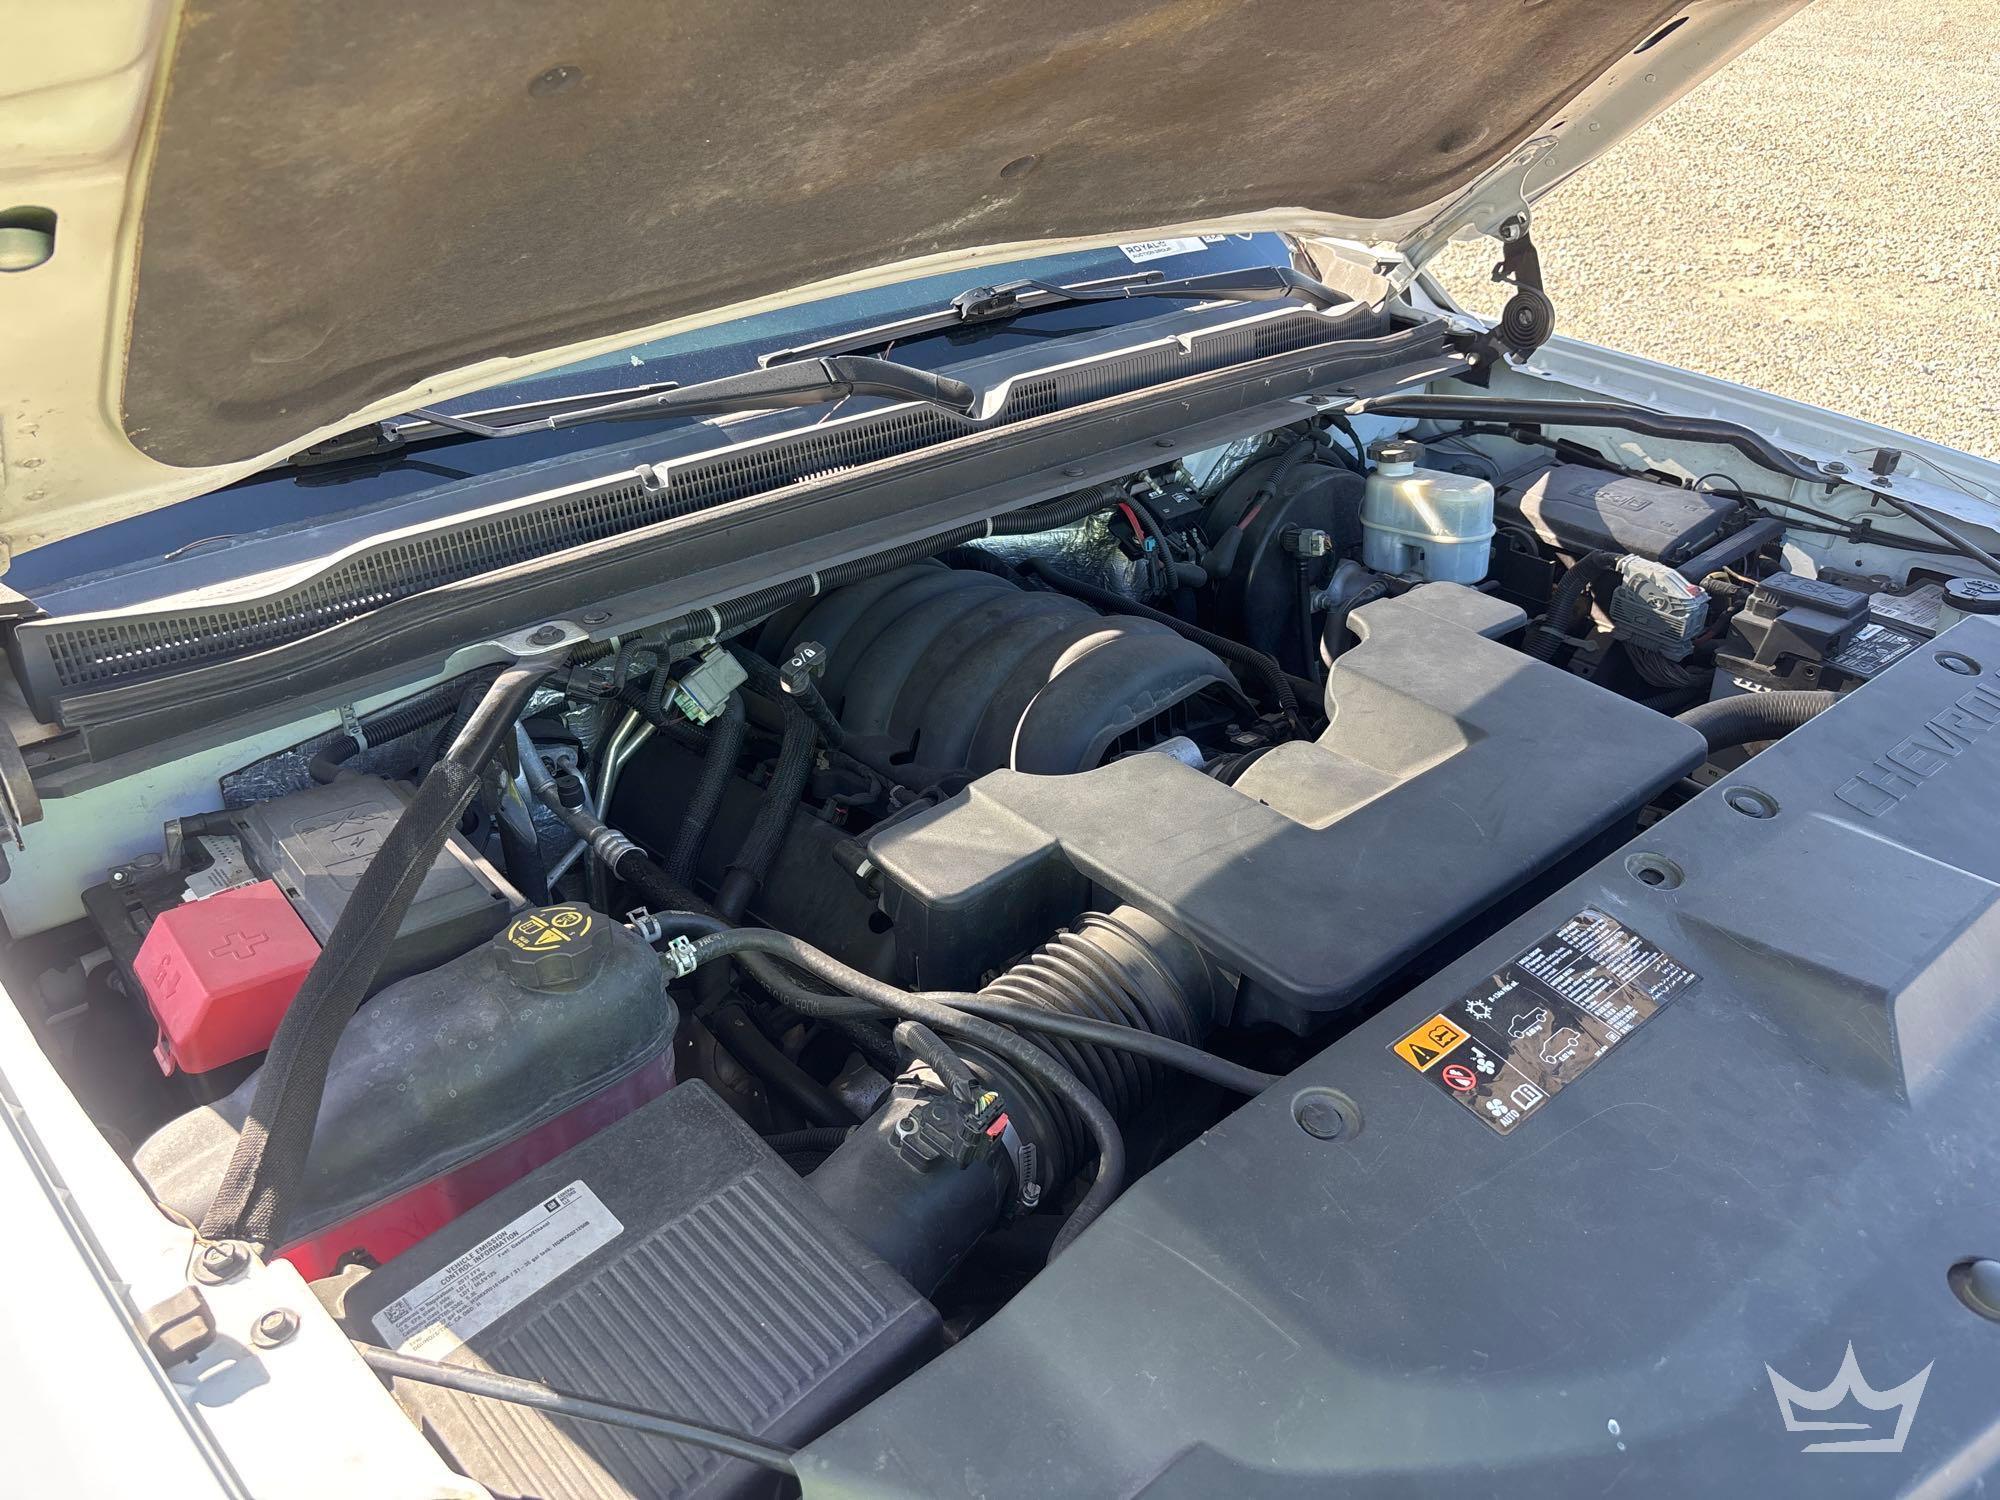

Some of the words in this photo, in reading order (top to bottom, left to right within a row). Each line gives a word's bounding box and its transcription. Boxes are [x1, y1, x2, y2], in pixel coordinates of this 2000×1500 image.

[1125, 241, 1160, 254] ROYAL
[1500, 1109, 1520, 1128] AUTO
[439, 1260, 474, 1286] CONTROL
[472, 1229, 519, 1263] INFORMATION
[445, 1251, 475, 1274] VEHICLE
[474, 1230, 508, 1254] EMISSION
